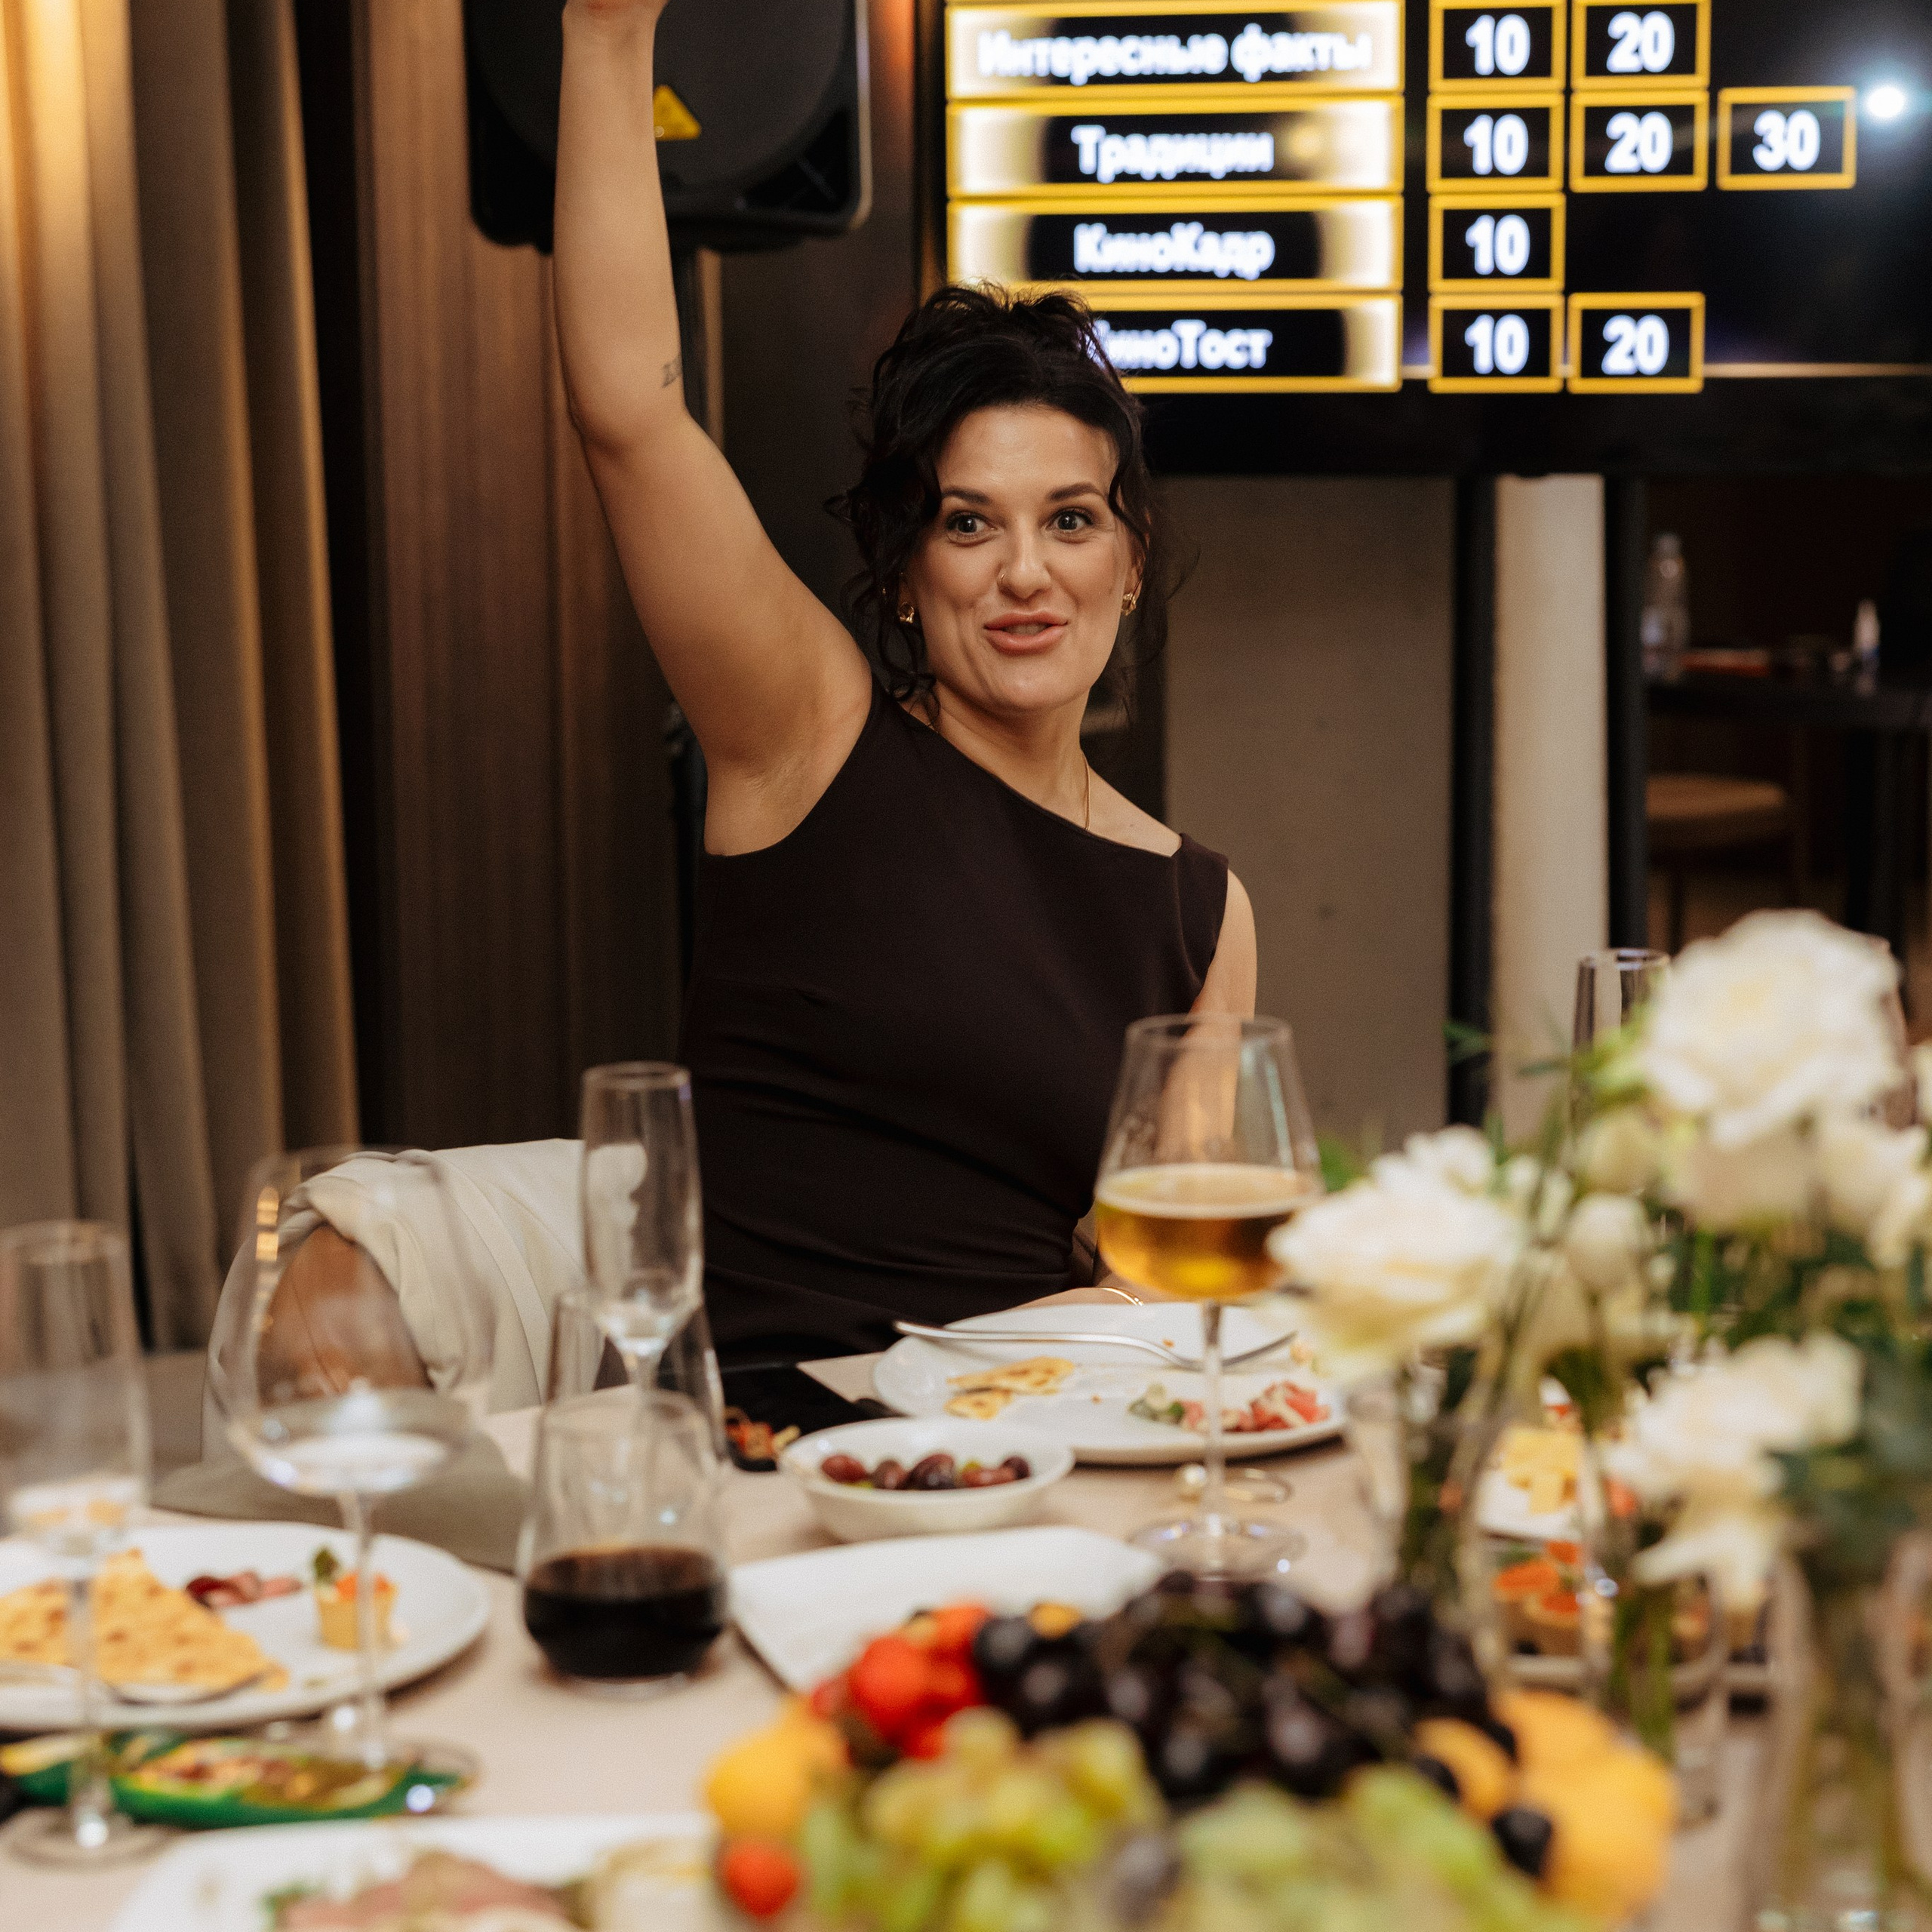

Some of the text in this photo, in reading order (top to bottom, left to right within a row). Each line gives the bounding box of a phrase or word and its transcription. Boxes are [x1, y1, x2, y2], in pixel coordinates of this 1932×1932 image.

[980, 23, 1372, 86] Интересные факты
[1466, 14, 1531, 76] 10
[1606, 11, 1675, 72] 20
[1071, 125, 1275, 183] Традиции
[1463, 114, 1529, 176] 10
[1604, 111, 1673, 173] 20
[1752, 109, 1821, 171] 30
[1073, 222, 1275, 280] КиноКадр
[1465, 214, 1531, 275] 10
[1465, 314, 1530, 376] 10
[1601, 315, 1669, 376] 20
